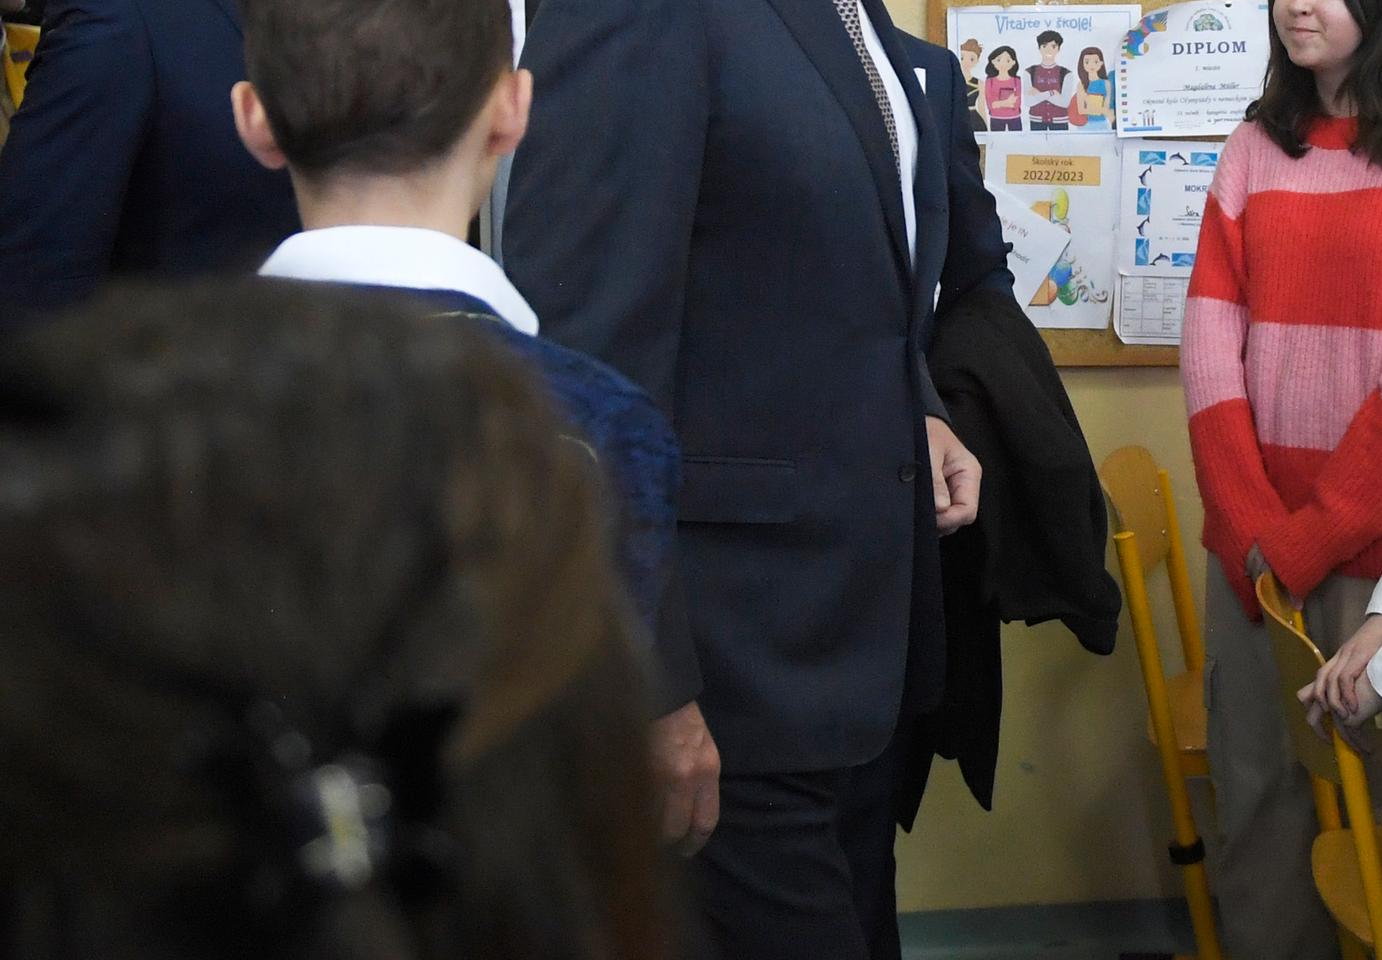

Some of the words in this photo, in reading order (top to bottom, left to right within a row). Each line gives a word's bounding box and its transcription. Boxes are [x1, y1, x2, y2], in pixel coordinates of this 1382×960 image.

[995, 15, 1040, 34] Vitajte
[1056, 16, 1092, 32] škole!
[1172, 40, 1247, 55] DIPLOM
[1031, 156, 1059, 167] Školský
[1060, 158, 1073, 166] rok
[1023, 170, 1084, 182] 2022/2023
